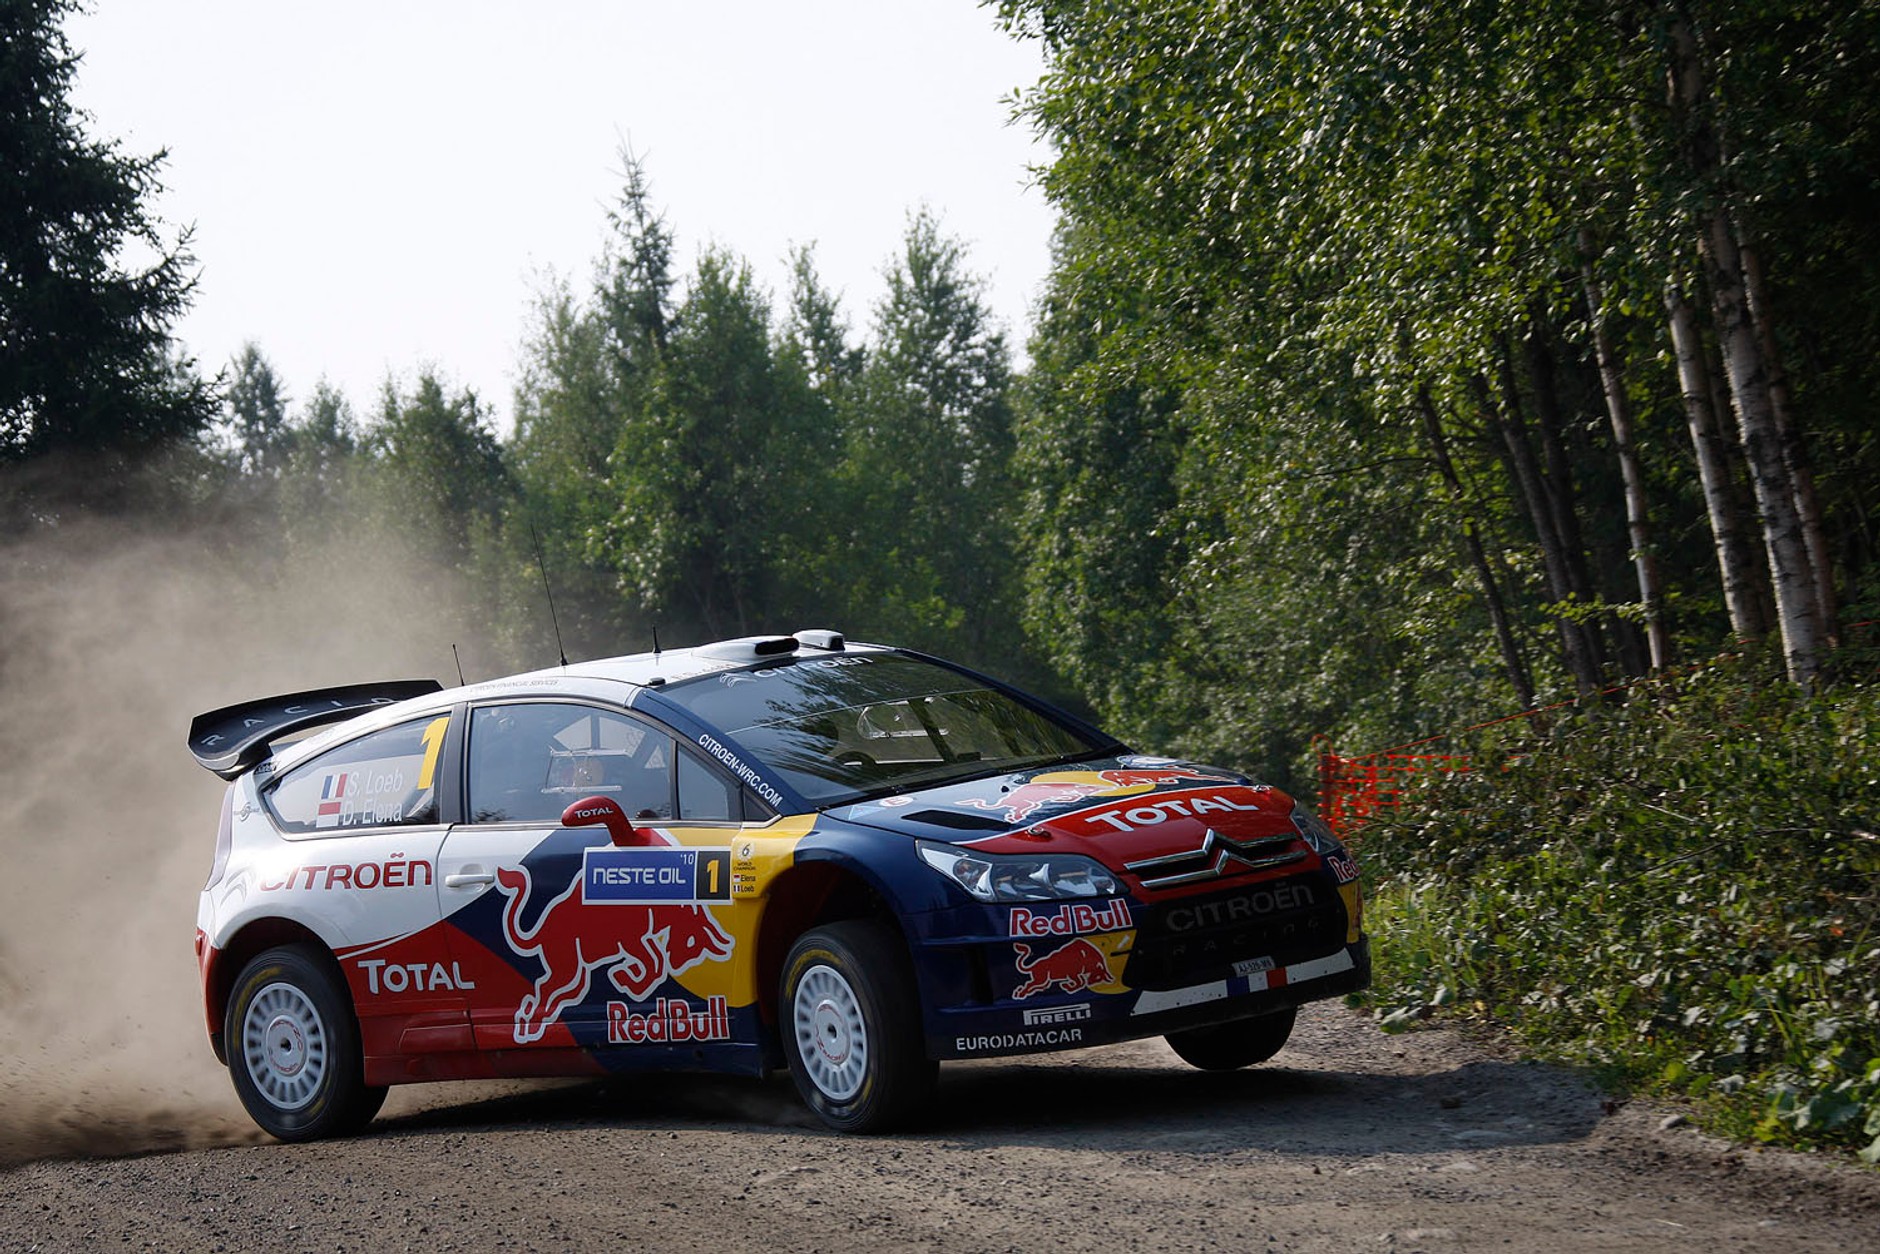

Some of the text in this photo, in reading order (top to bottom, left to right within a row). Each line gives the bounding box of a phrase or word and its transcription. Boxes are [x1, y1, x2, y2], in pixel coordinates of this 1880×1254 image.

[753, 656, 874, 678] CITROËN
[417, 717, 449, 790] 1
[698, 734, 783, 807] CITROEN-WRC.COM
[366, 770, 403, 795] Loeb
[362, 798, 403, 823] Elena
[574, 806, 614, 819] TOTAL
[1084, 796, 1259, 832] TOTAL
[259, 852, 433, 892] CITROËN
[593, 867, 687, 885] NESTE OIL
[706, 859, 720, 894] 1
[1009, 898, 1132, 938] Red Bull
[1166, 881, 1314, 932] CITROËN
[357, 960, 475, 995] TOTAL
[607, 995, 730, 1044] Red Bull
[1023, 1003, 1091, 1026] PIRELLI
[956, 1029, 1082, 1051] EURODATACAR
